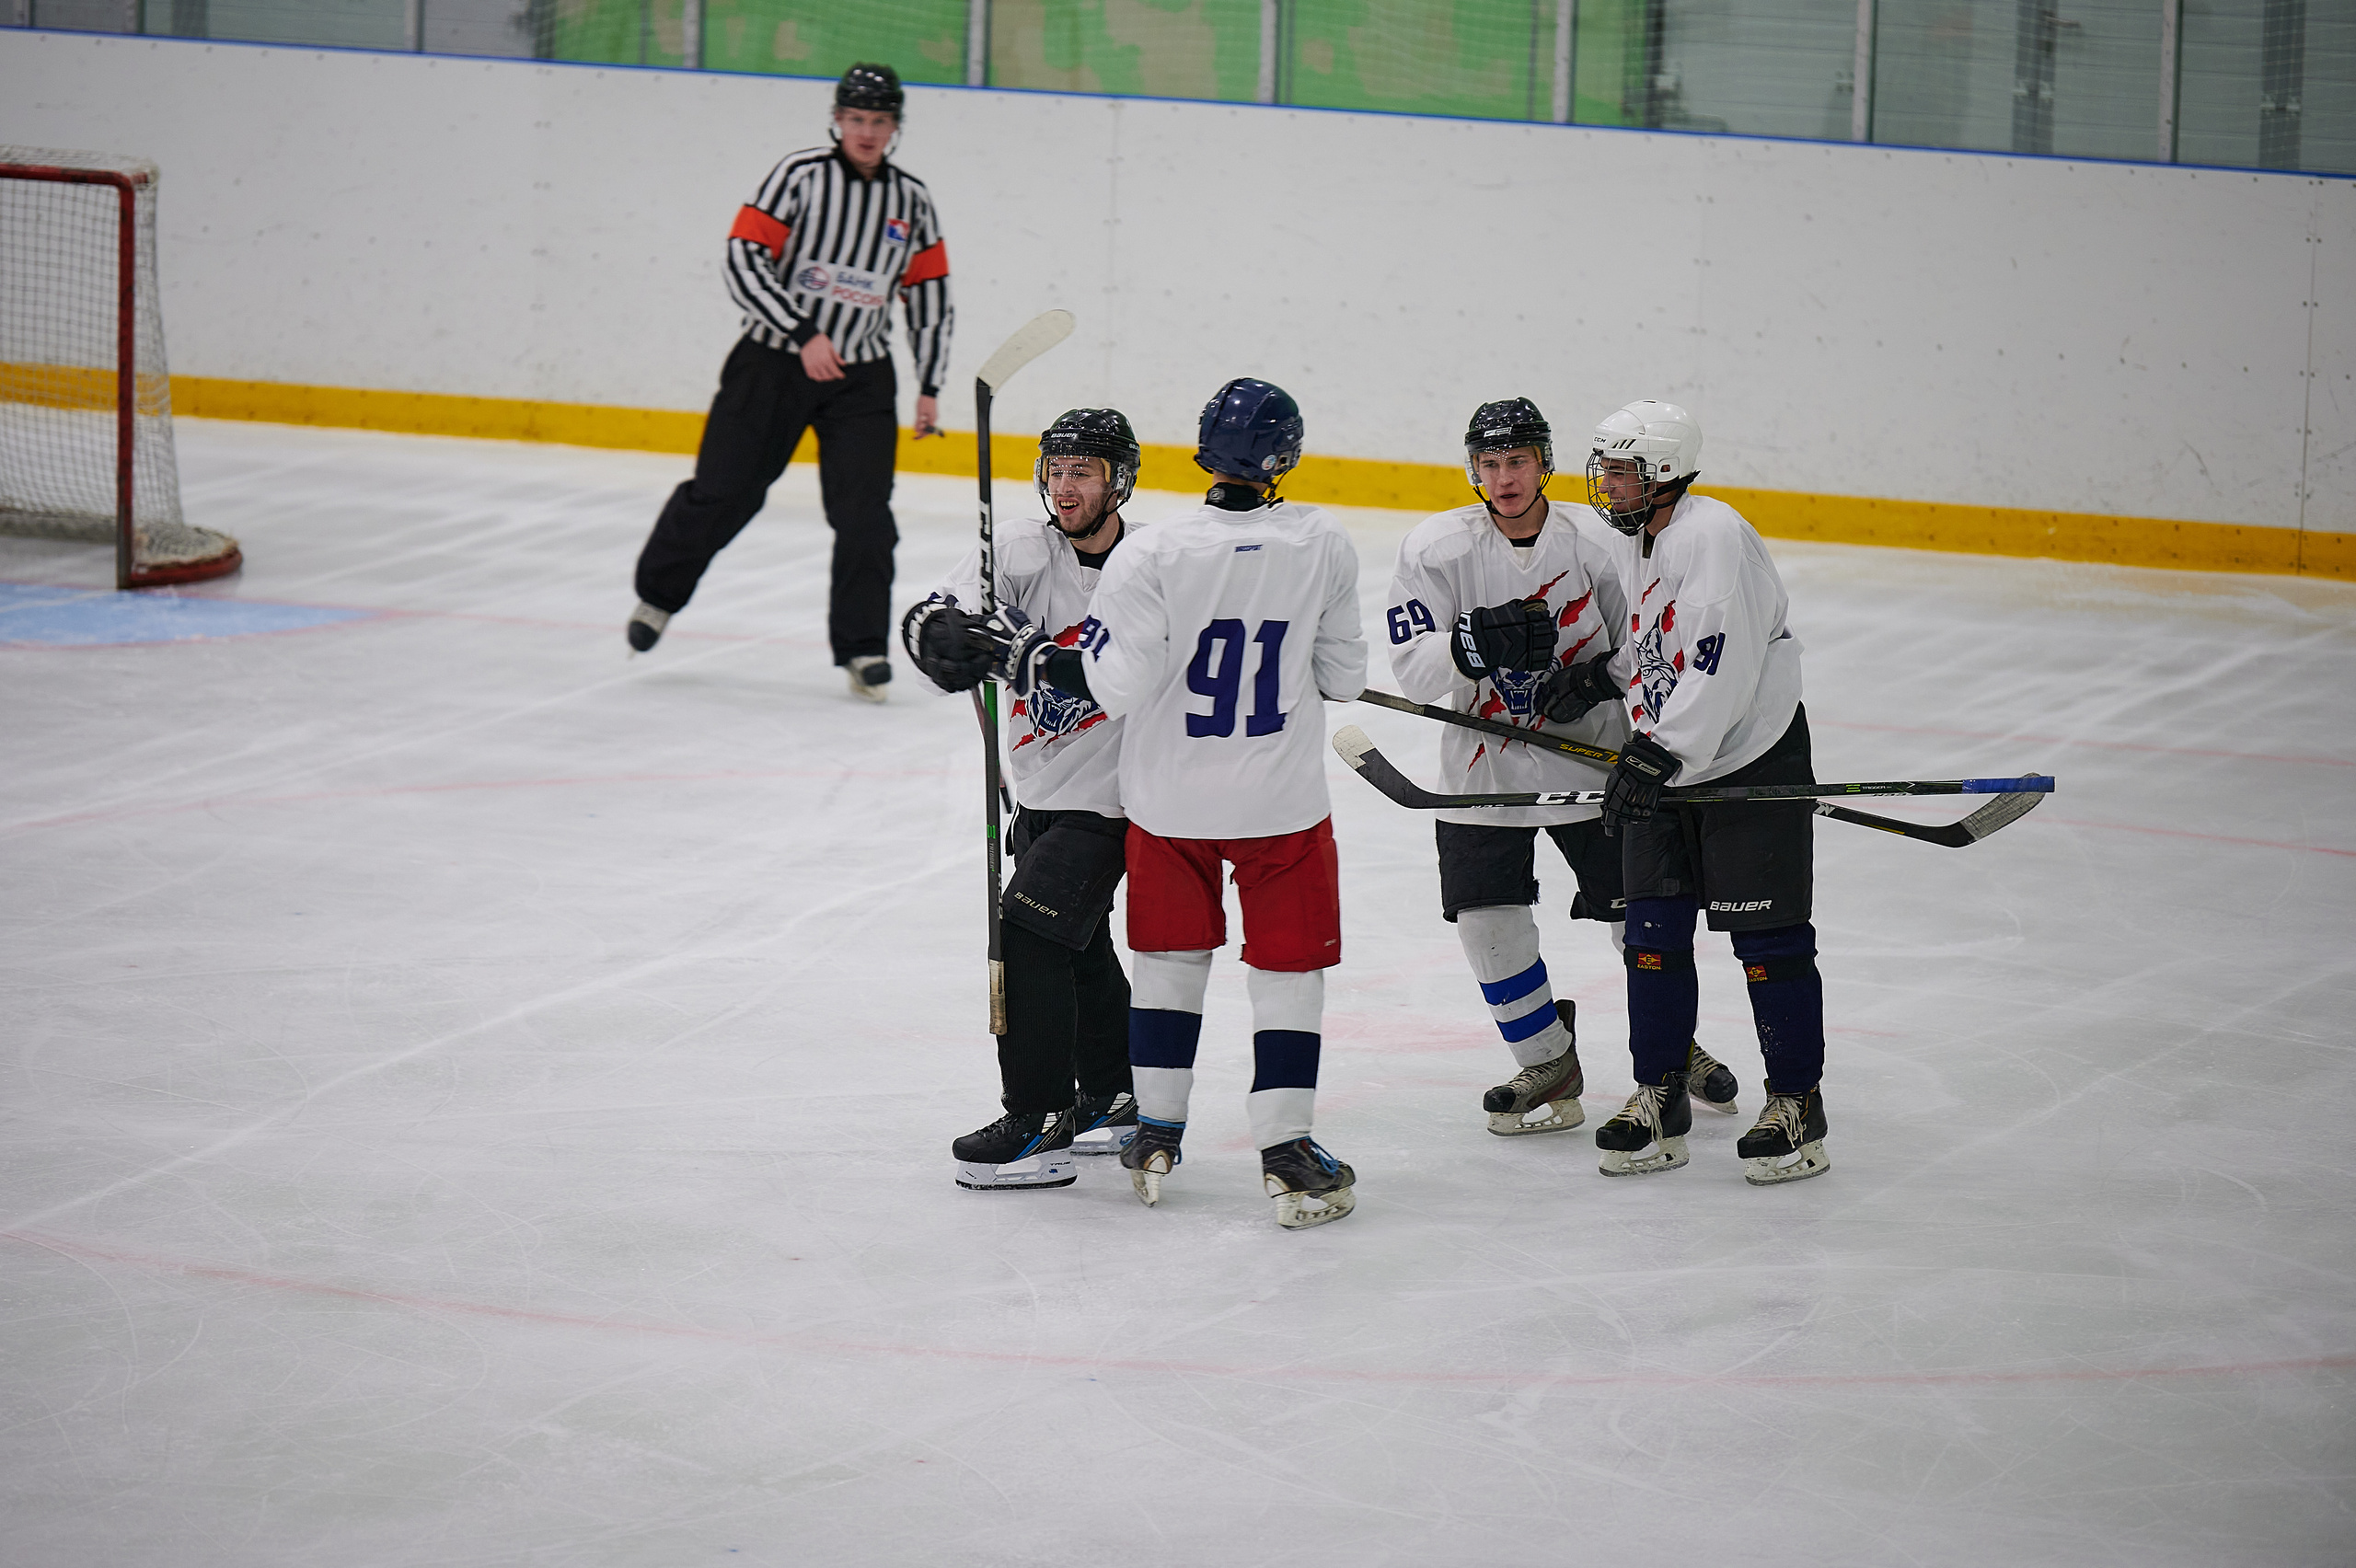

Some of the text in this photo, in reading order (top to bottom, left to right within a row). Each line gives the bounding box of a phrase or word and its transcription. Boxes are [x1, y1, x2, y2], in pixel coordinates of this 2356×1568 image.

[979, 502, 993, 613] CCM
[1080, 615, 1110, 663] 91
[1387, 598, 1436, 645] 69
[1692, 632, 1727, 676] 91
[1185, 618, 1289, 738] 91
[1559, 743, 1603, 759] SUPER
[1710, 899, 1773, 912] BAUER
